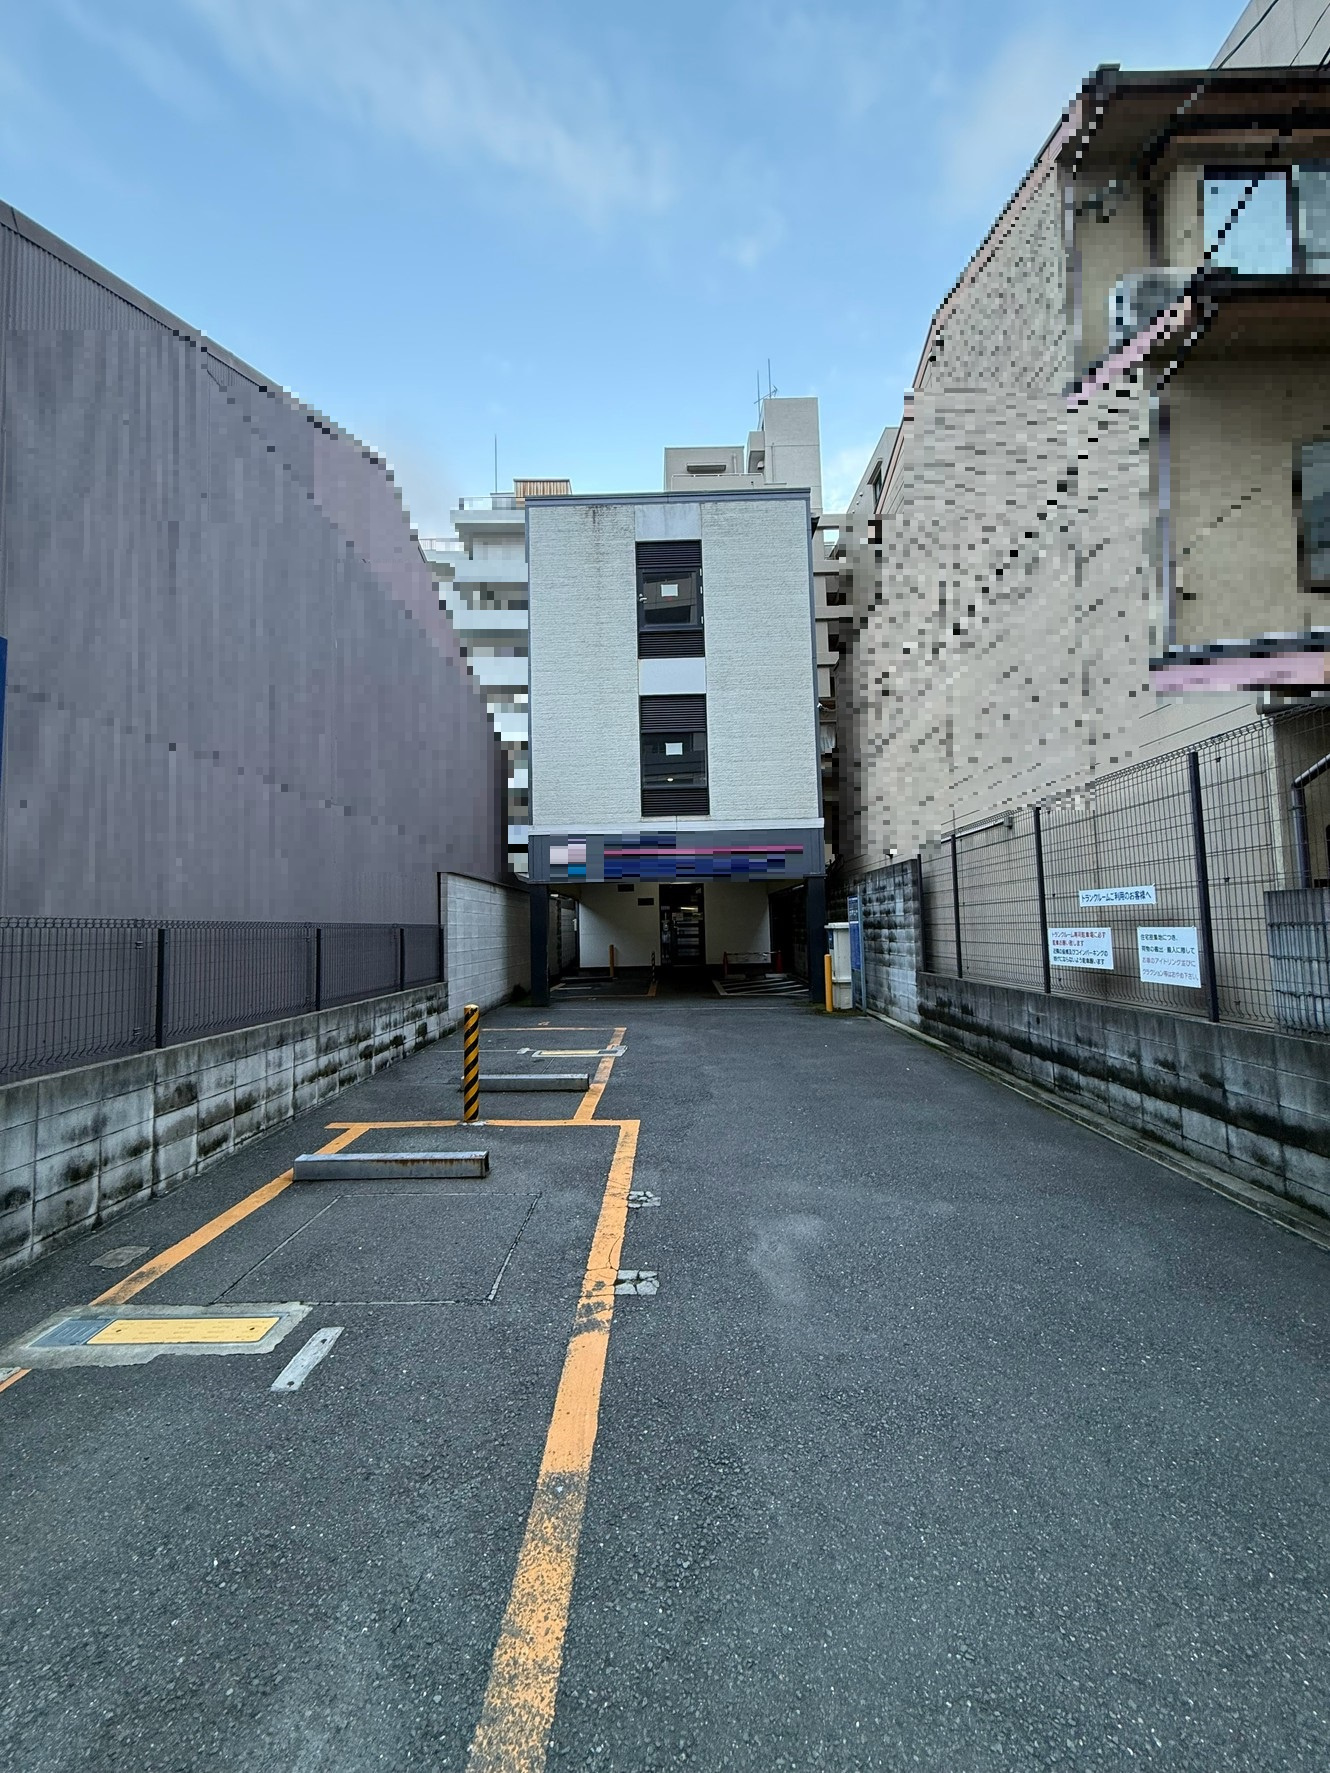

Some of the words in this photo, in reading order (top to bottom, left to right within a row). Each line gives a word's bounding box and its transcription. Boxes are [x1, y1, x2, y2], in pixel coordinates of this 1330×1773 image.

[1081, 890, 1152, 903] トランクルームご利用のお客様へ
